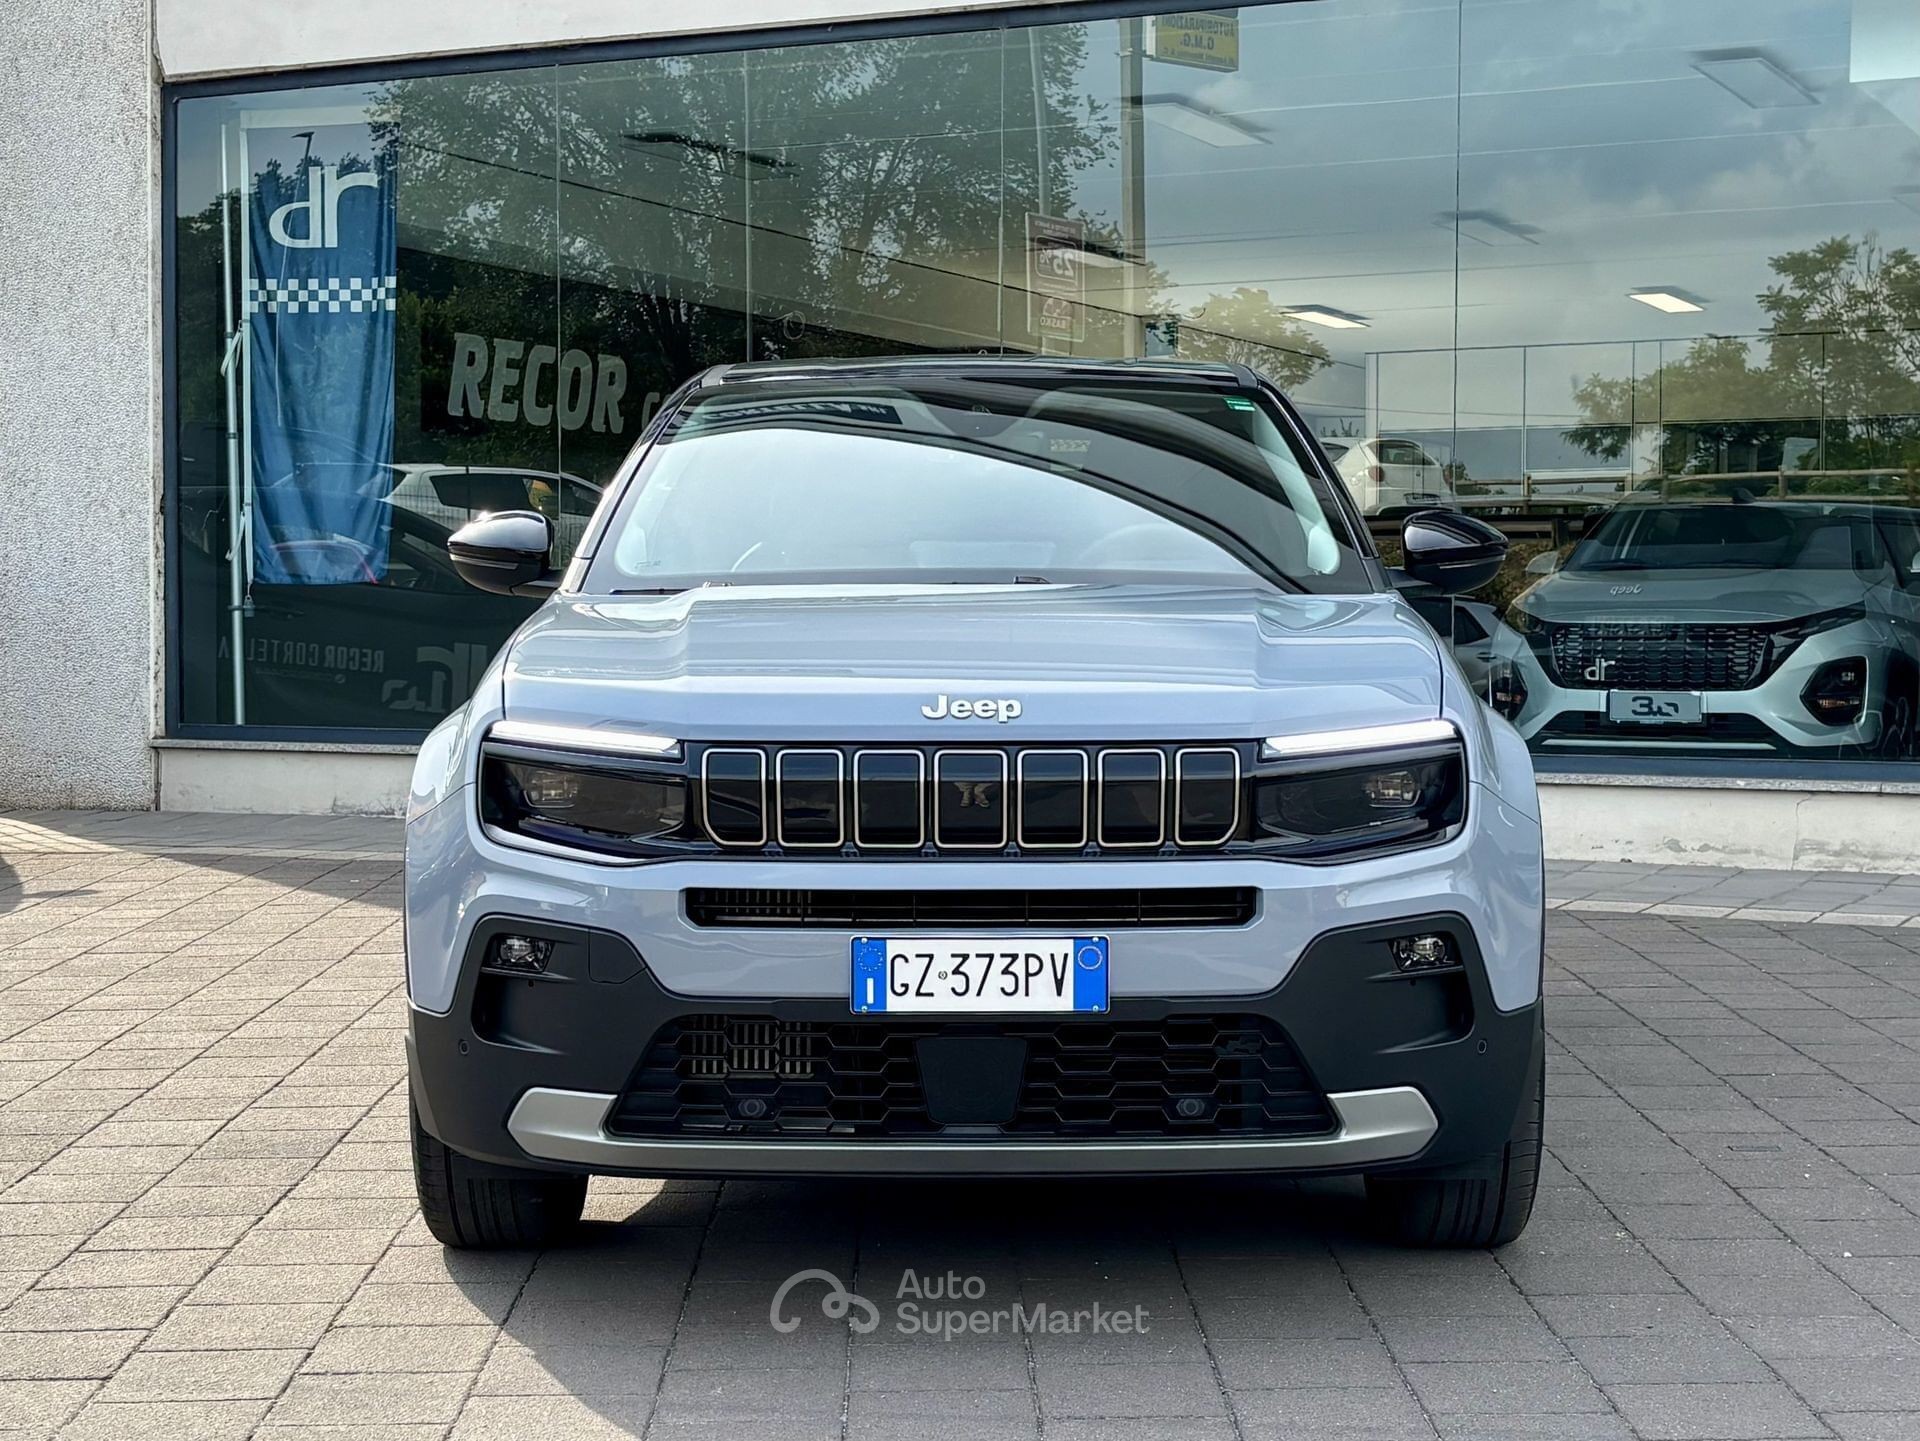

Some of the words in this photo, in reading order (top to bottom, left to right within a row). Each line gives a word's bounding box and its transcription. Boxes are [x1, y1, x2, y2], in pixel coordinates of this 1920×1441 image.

[268, 166, 378, 249] dr
[447, 332, 628, 434] RECOR
[921, 694, 1023, 724] Jeep
